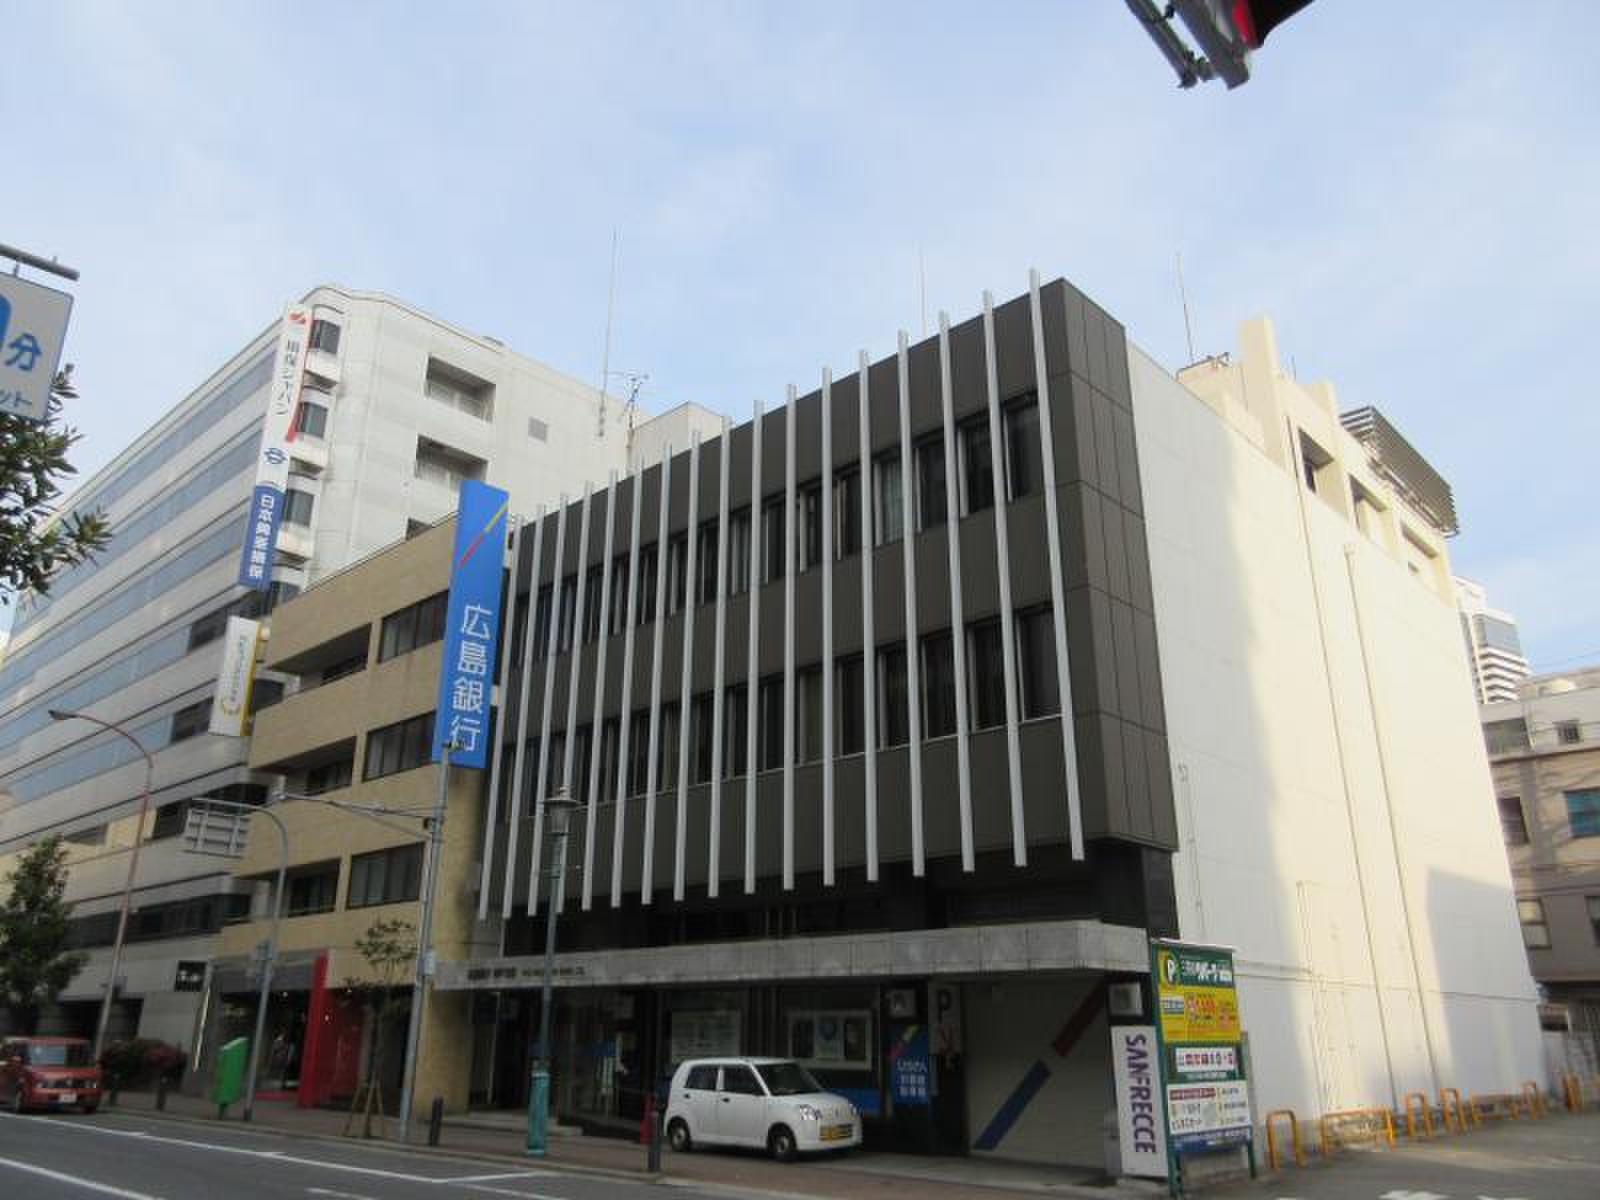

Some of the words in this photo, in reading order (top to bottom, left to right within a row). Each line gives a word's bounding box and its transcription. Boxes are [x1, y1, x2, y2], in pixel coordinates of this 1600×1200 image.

[451, 604, 492, 751] 広島銀行
[1125, 1033, 1156, 1153] SANFRECCE
